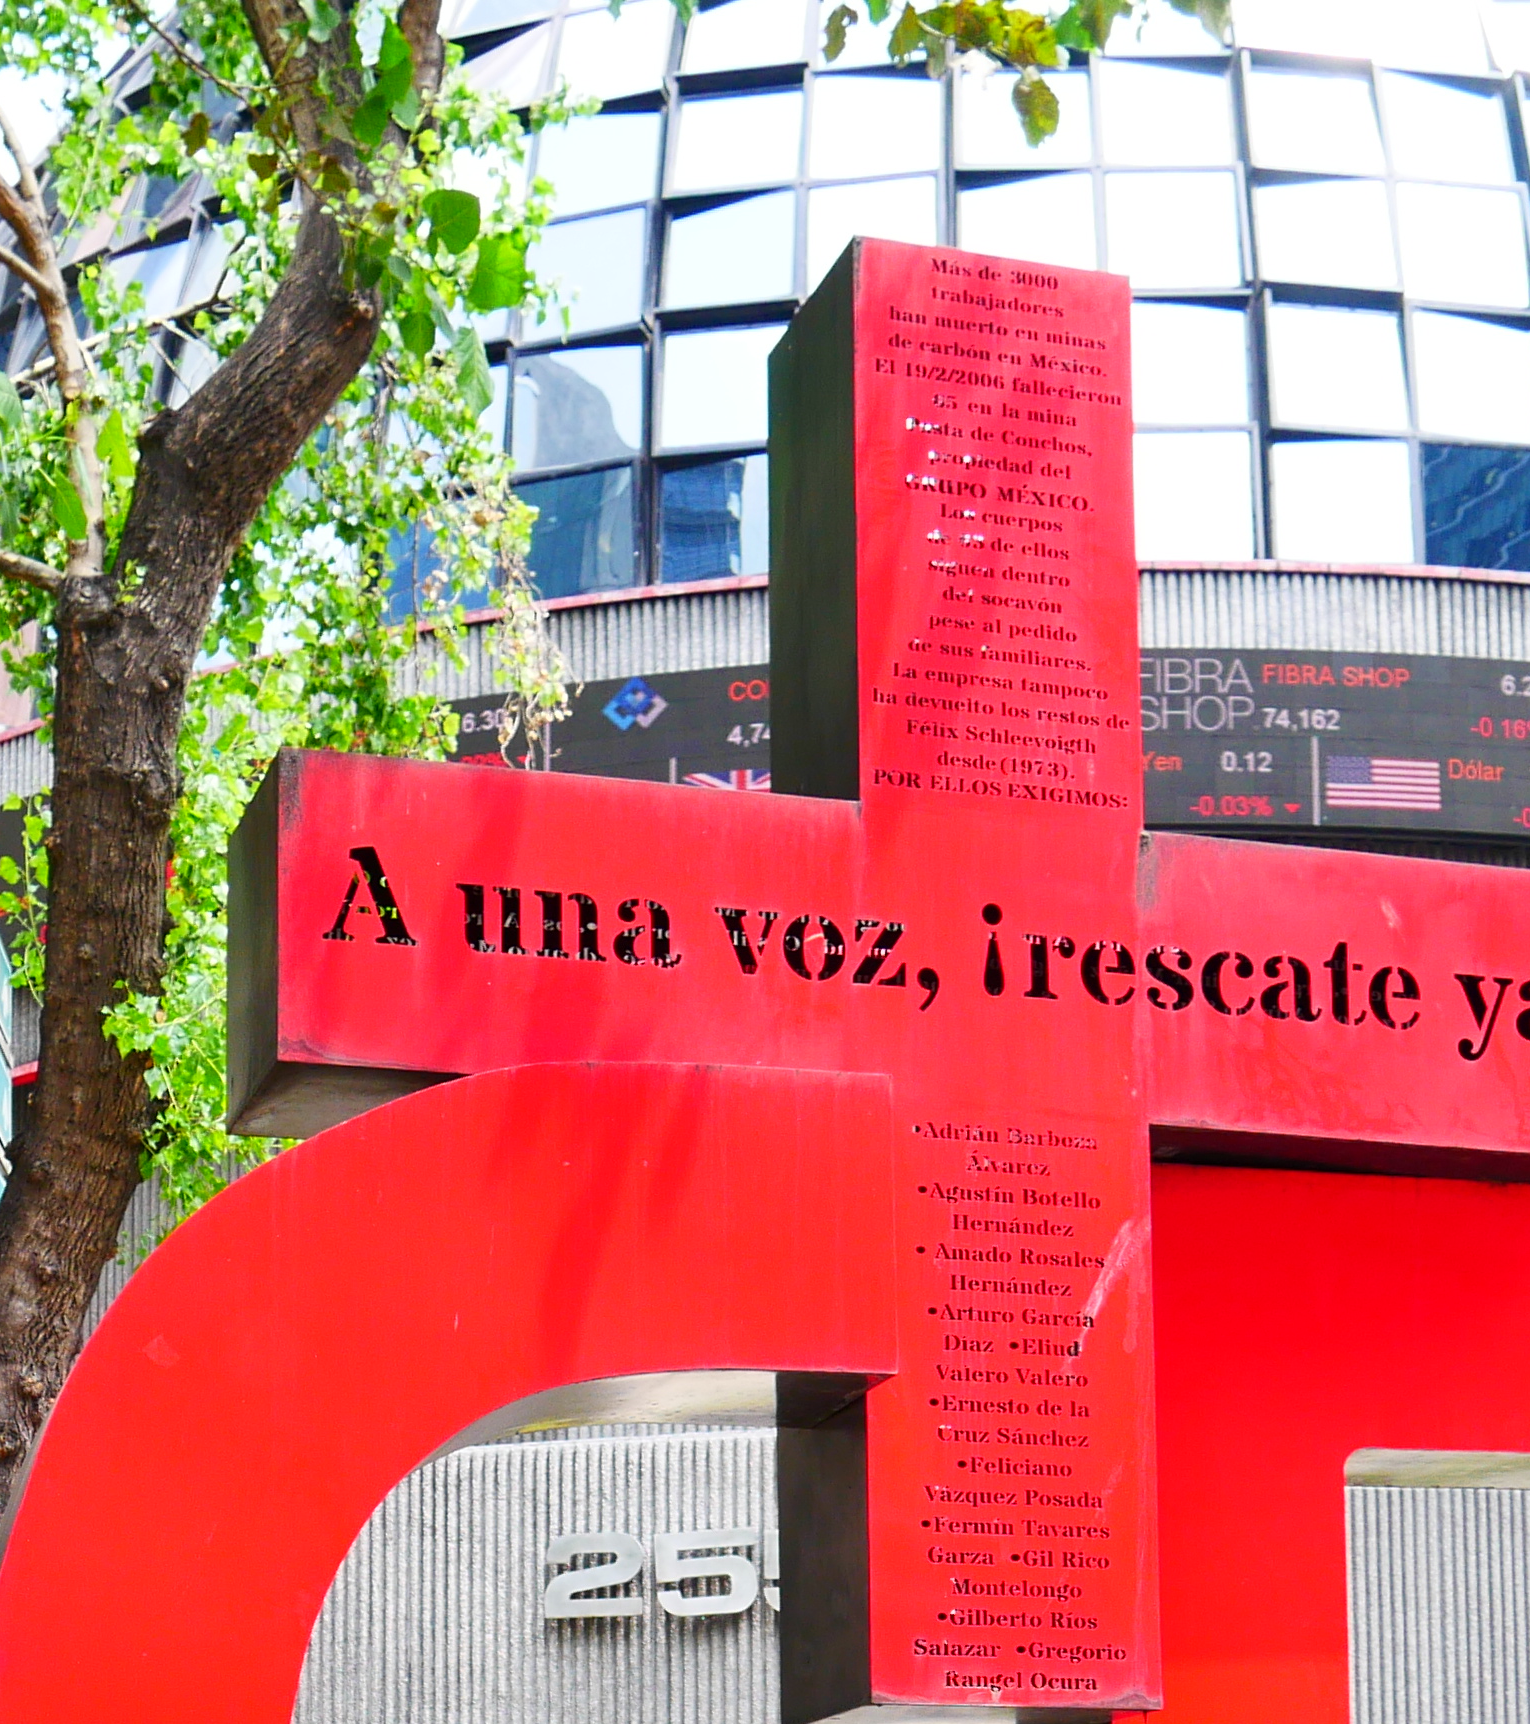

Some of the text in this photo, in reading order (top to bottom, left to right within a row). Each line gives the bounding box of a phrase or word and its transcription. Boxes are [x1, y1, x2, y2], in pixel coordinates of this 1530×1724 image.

[931, 258, 1058, 291] Más de 3000
[931, 287, 1065, 319] trabajadores
[890, 306, 1107, 351] han muerto en minas
[889, 333, 1107, 377] de carbón en México.
[875, 359, 896, 374] El
[1012, 377, 1122, 406] fallecieron
[968, 400, 992, 415] en
[1002, 403, 1020, 419] la
[1027, 409, 1078, 428] mina
[971, 426, 995, 443] de
[1002, 430, 1093, 458] Conchos,
[928, 450, 1071, 480] propiedad del
[997, 483, 1095, 513] MÉXICO.
[940, 503, 1063, 534] Los cuerpos
[991, 538, 1014, 554] de
[1021, 542, 1070, 561] ellos
[1002, 566, 1070, 588] dentro
[981, 593, 1063, 614] socavón
[929, 615, 1078, 644] pese al pedido
[908, 638, 1092, 672] de sus familiares.
[893, 663, 1108, 701] La empresa tampoco
[1261, 663, 1410, 688] FIBRA SHOP
[872, 688, 1130, 731] ha devuelto los restos de
[1263, 708, 1341, 732] 74,162
[906, 720, 958, 741] Félix
[937, 751, 997, 772] desde
[1142, 751, 1273, 772] Yen 0.12
[1447, 758, 1505, 782] Dólar
[873, 769, 1129, 810] POR ELLOS EXIGIMOS:
[322, 845, 419, 948] A
[455, 881, 683, 969] una
[713, 903, 940, 1013] voz,
[980, 902, 1423, 1031] ¡rescate
[923, 1121, 998, 1144] Adrián
[966, 1150, 1050, 1178] Álvarez
[929, 1183, 1101, 1209] Agustín Botello
[952, 1214, 1074, 1238] Hernández
[935, 1243, 1105, 1269] Amado Rosales
[950, 1275, 1072, 1298] Hernández
[940, 1304, 1094, 1328] Arturo García
[1021, 1339, 1081, 1358] Eliud
[936, 1363, 1089, 1388] Valero Valero
[941, 1395, 1090, 1418] Ernesto de la
[937, 1425, 1089, 1448] Cruz Sánchez
[970, 1457, 1072, 1478] Feliciano
[925, 1485, 1103, 1510] Vázquez Posada
[933, 1517, 1111, 1539] Fermín Tavares
[927, 1546, 1110, 1570] Garza Gil Rico
[544, 1527, 781, 1618] 25
[951, 1577, 1082, 1602] Montelongo
[949, 1609, 1098, 1630] Gilberto Ríos
[914, 1638, 1127, 1664] Salazar Gregorio
[945, 1670, 1098, 1692] Rangel Ocura
